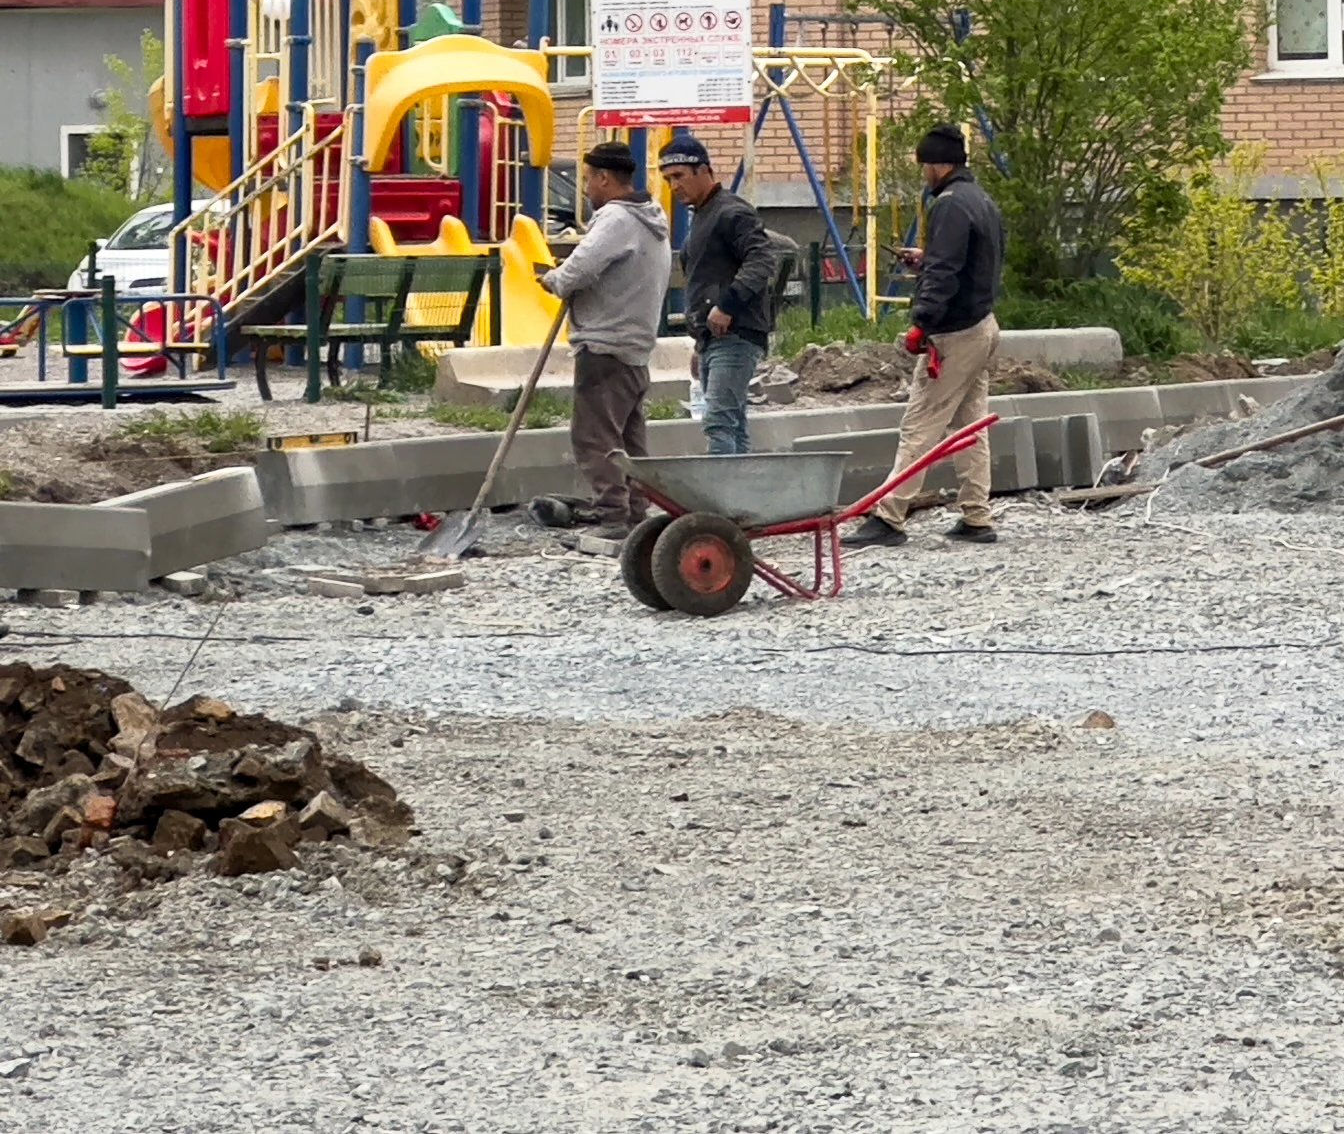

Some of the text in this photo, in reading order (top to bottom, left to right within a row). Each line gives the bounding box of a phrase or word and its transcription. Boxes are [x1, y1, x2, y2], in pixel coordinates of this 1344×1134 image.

[600, 36, 638, 46] НОМЕРА
[642, 35, 704, 45] ЭКСТРЕННЫХ
[604, 50, 617, 59] 01
